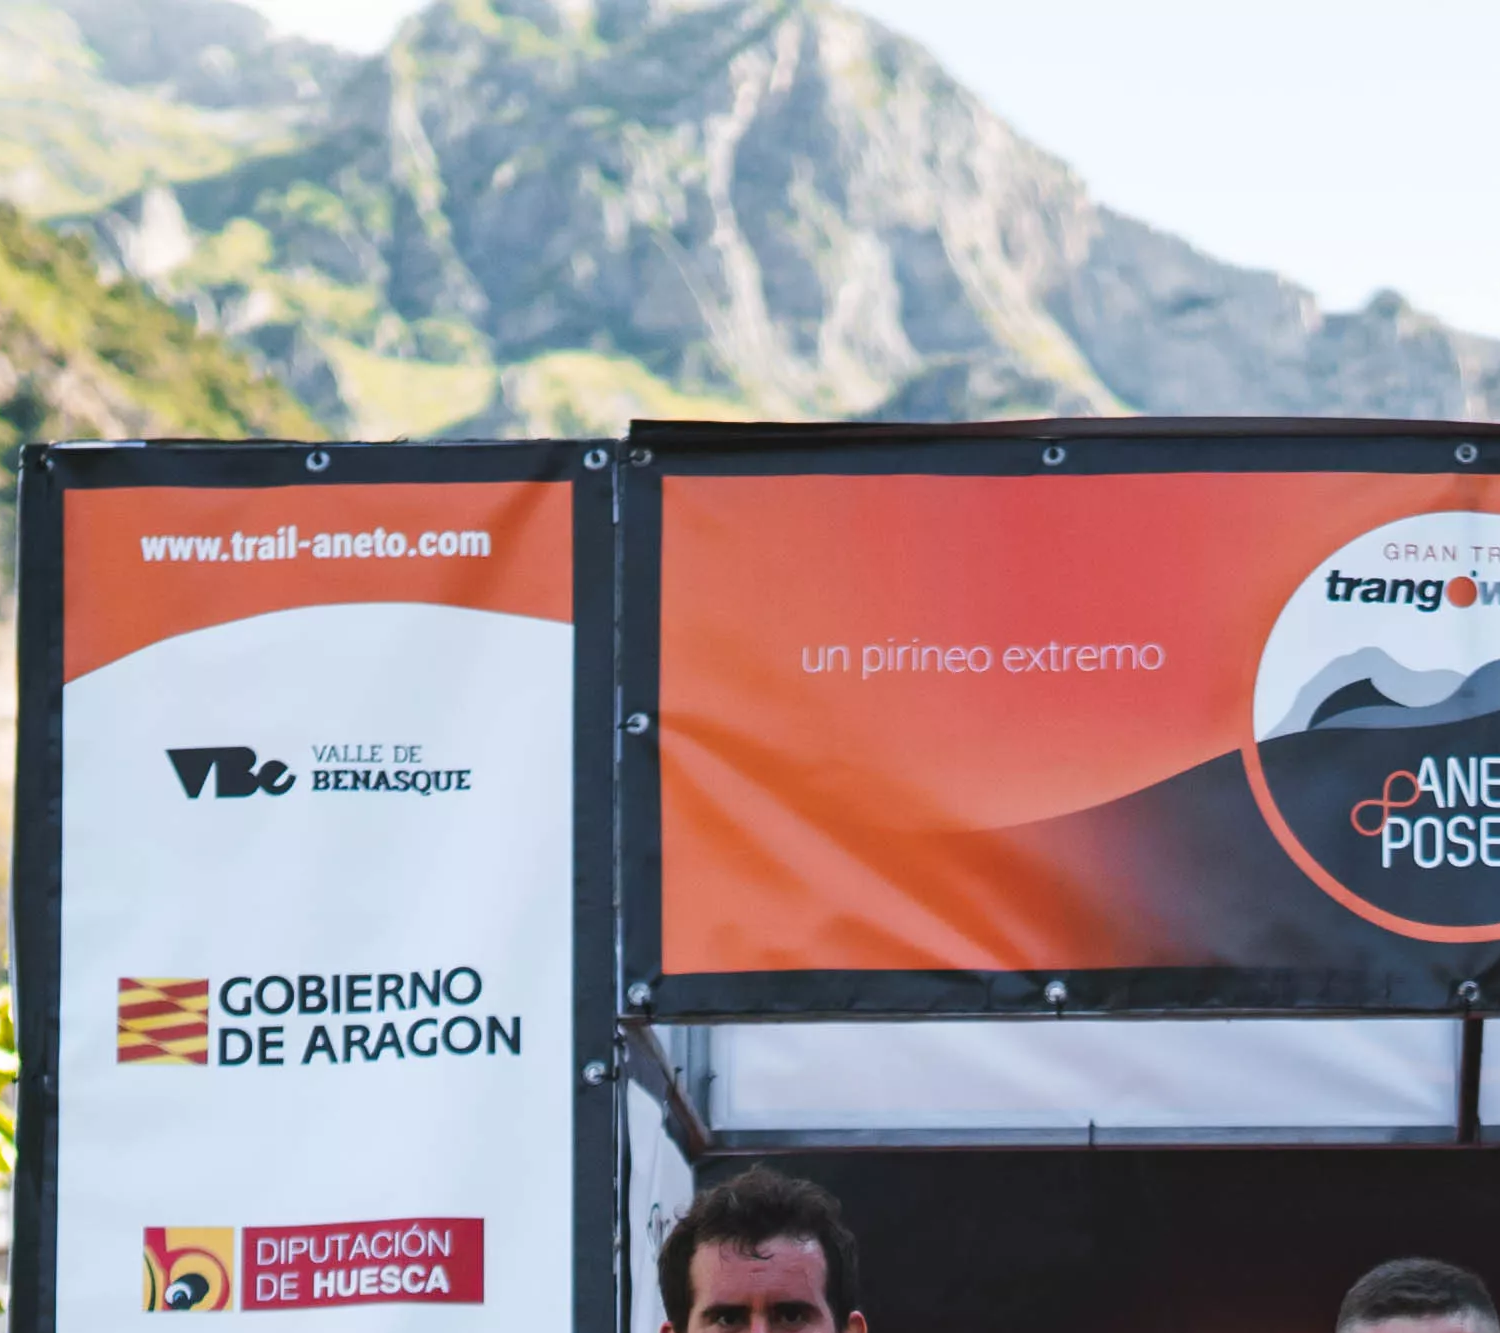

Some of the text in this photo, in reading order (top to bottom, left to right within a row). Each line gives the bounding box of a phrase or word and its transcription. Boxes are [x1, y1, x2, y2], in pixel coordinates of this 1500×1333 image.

[141, 527, 491, 561] www.trail-aneto.com
[1383, 543, 1458, 562] GRAN
[802, 639, 1165, 680] un pirineo extremo
[312, 745, 422, 764] VALLE DE
[312, 769, 472, 796] BENASQUE
[218, 967, 482, 1017] GOBIERNO
[218, 1016, 522, 1067] DE ARAGON
[255, 1225, 451, 1267] DIPUTACIÓN
[255, 1265, 450, 1301] DE HUESCA
